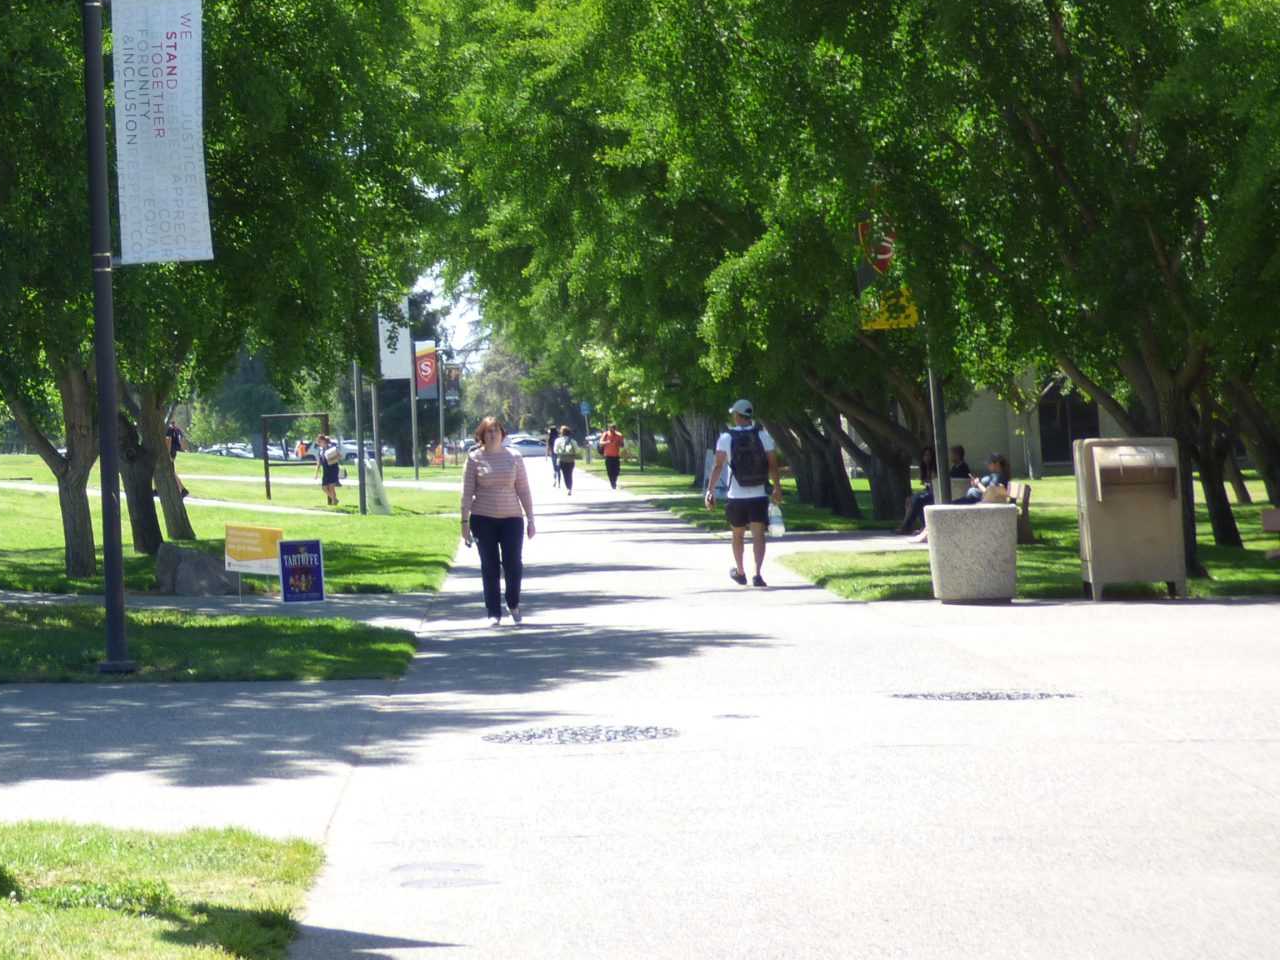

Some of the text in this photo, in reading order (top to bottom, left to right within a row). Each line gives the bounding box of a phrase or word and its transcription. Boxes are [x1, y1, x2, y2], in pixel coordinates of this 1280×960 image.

[180, 12, 193, 41] WE
[151, 41, 166, 138] TOGETHER
[165, 31, 178, 90] STAND
